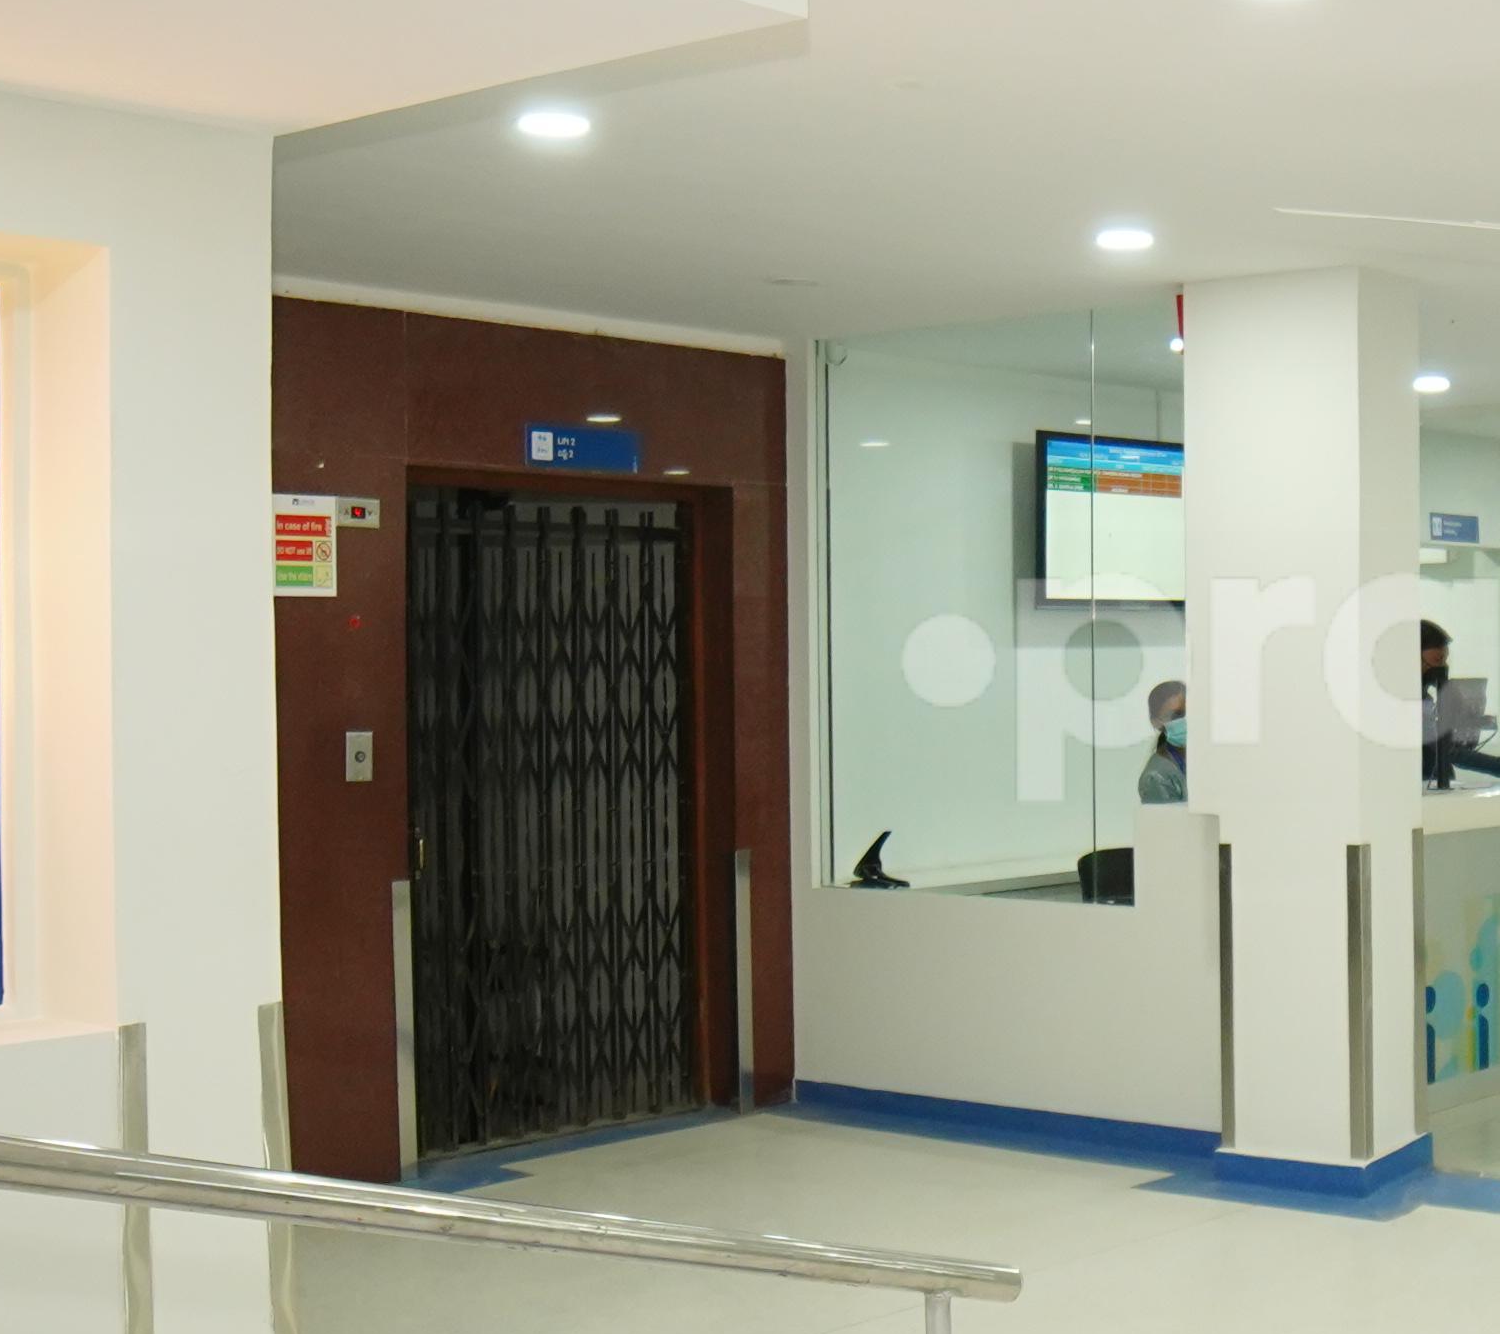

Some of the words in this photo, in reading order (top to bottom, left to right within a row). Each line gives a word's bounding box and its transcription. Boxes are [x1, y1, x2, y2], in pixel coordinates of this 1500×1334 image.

[570, 437, 576, 447] 2
[284, 521, 302, 531] case
[302, 522, 310, 532] of
